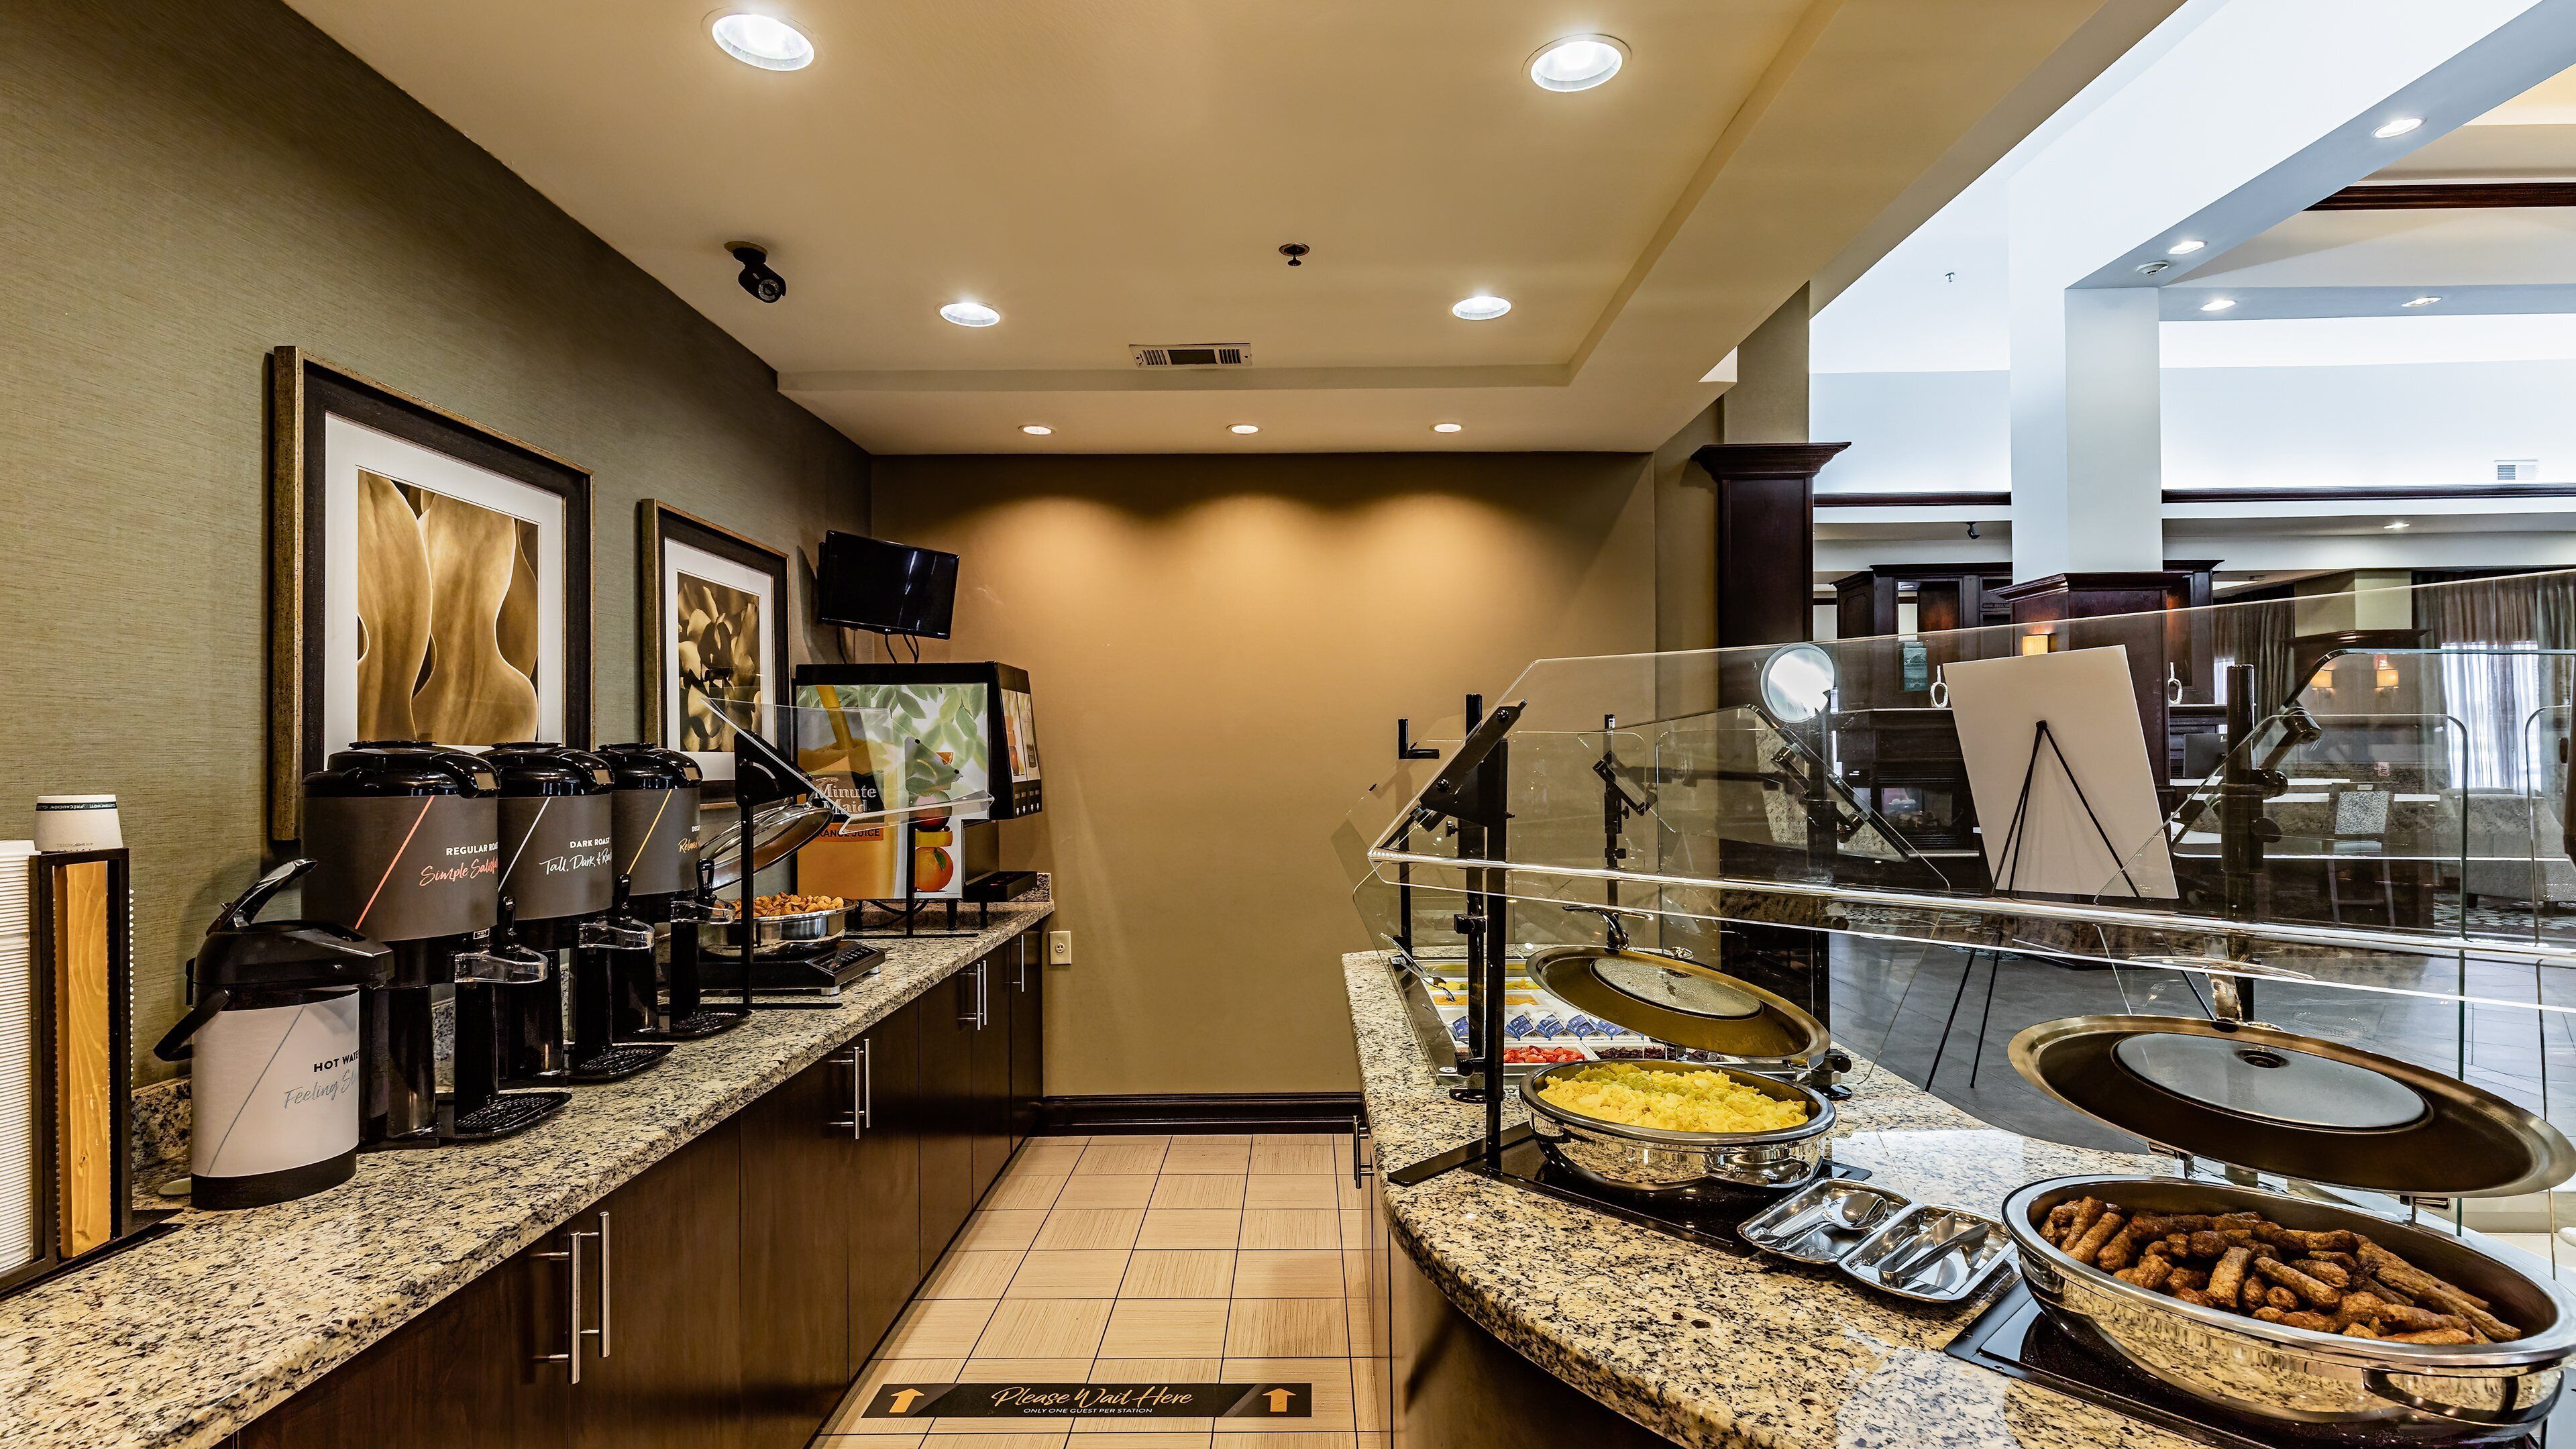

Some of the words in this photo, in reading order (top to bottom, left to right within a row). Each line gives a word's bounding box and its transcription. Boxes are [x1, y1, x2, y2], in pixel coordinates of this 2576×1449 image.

[814, 784, 877, 799] Minute
[822, 799, 867, 814] Maid
[852, 828, 879, 837] JUICE
[445, 845, 488, 855] REGULAR
[570, 840, 593, 849] DARK
[594, 837, 610, 846] ROAST
[539, 856, 569, 875] Tall,
[570, 855, 596, 869] Dark
[419, 865, 468, 886] Simple
[313, 1058, 339, 1073] HOT
[342, 1050, 360, 1065] WATE
[284, 1081, 339, 1109] Feeling
[991, 1387, 1071, 1407] Please
[1073, 1388, 1133, 1408] Wait
[1131, 1385, 1194, 1409] Here
